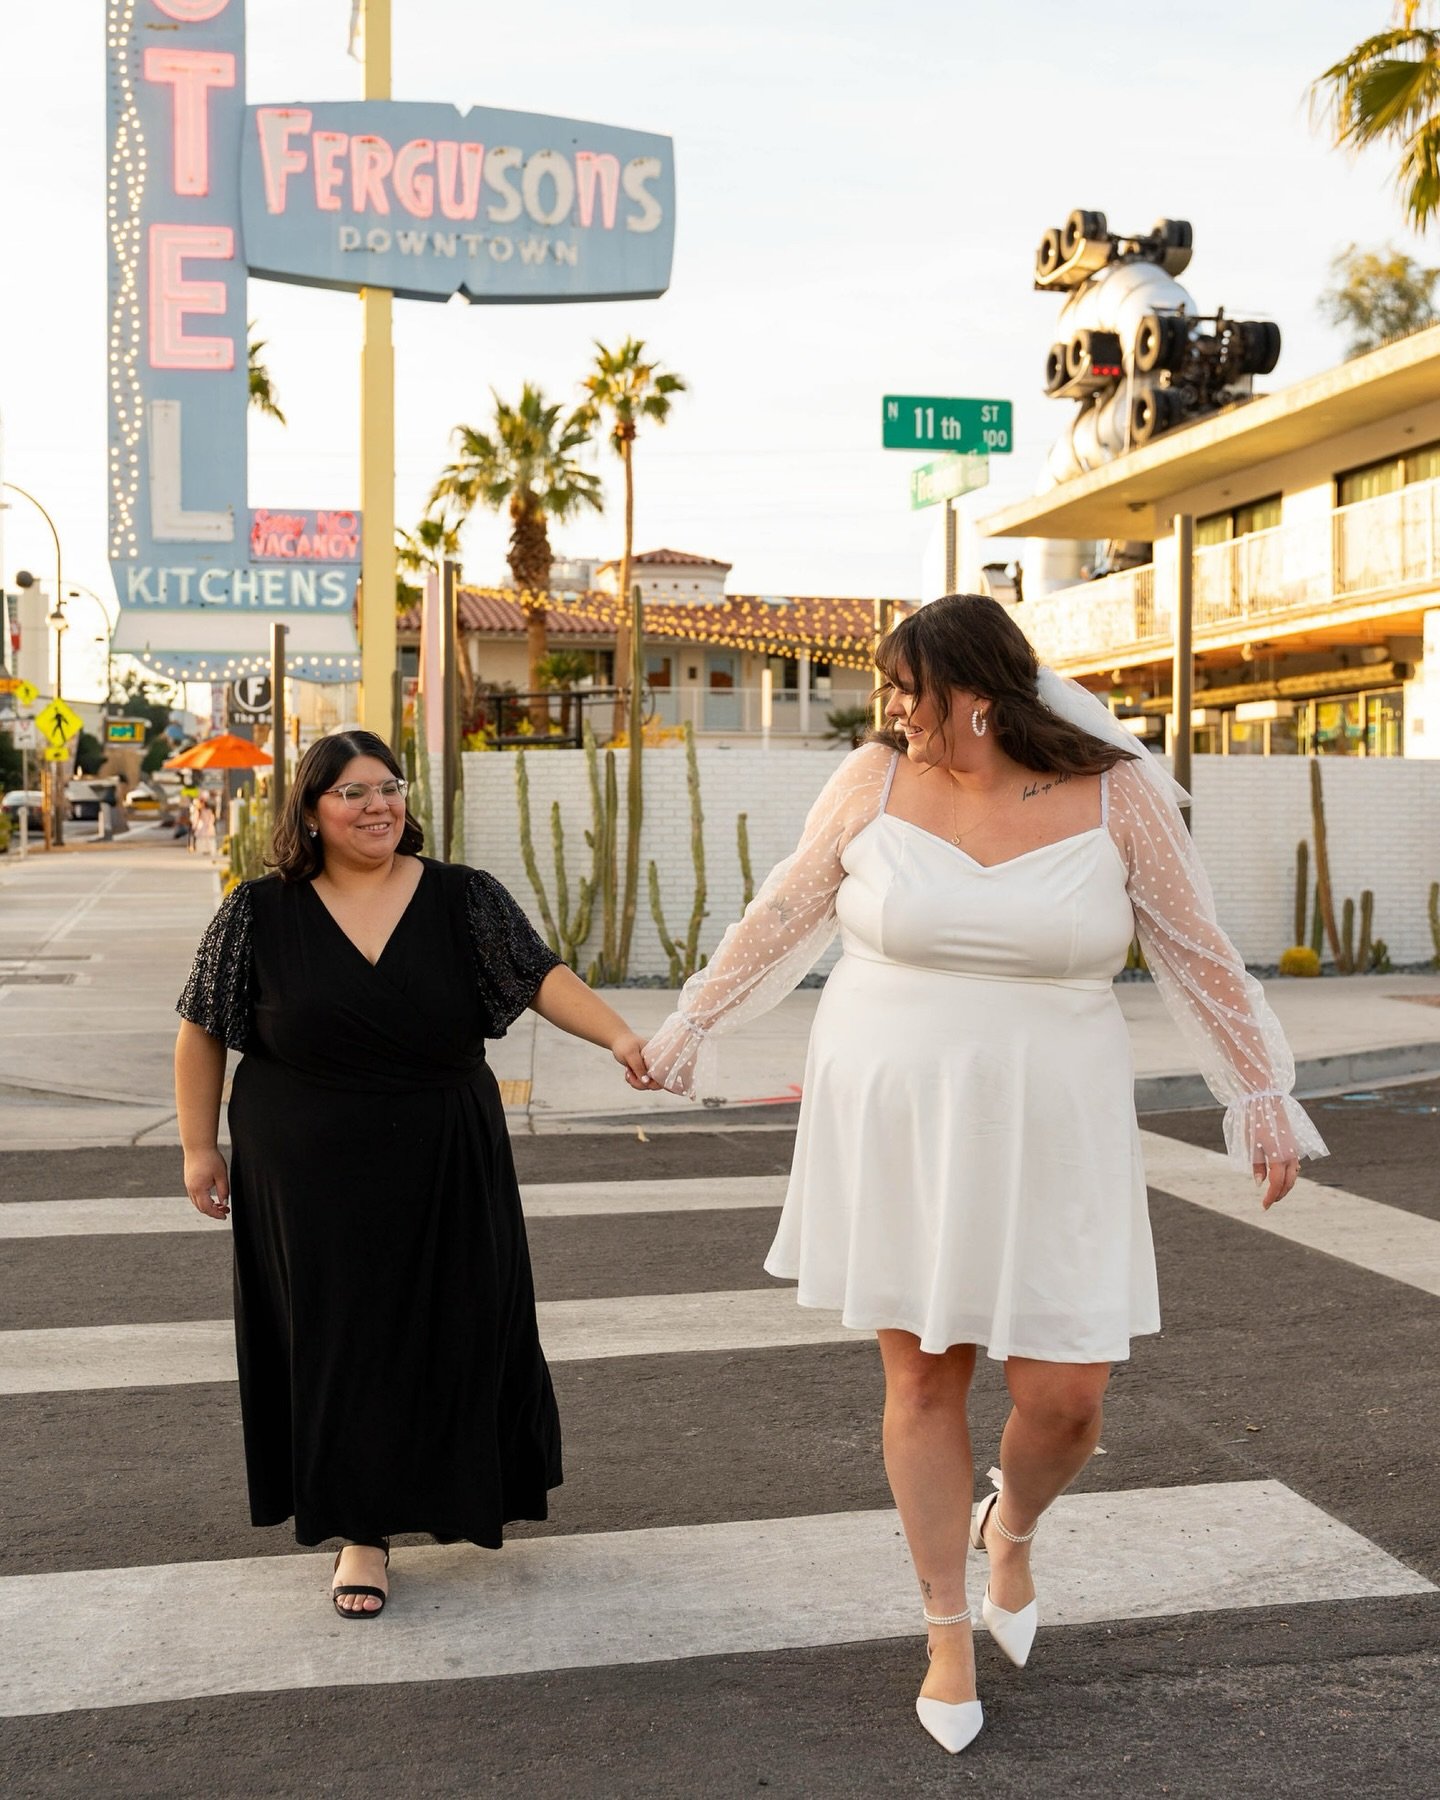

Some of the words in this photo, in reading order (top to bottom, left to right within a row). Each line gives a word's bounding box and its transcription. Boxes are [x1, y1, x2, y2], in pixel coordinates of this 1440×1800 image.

[339, 226, 579, 267] DOWNTOWN
[143, 0, 237, 543] TEL
[887, 401, 899, 420] N
[981, 405, 999, 423] ST
[982, 429, 1008, 448] 100
[316, 511, 358, 534] NO
[252, 533, 360, 559] VACANCY
[127, 566, 348, 607] KITCHENS
